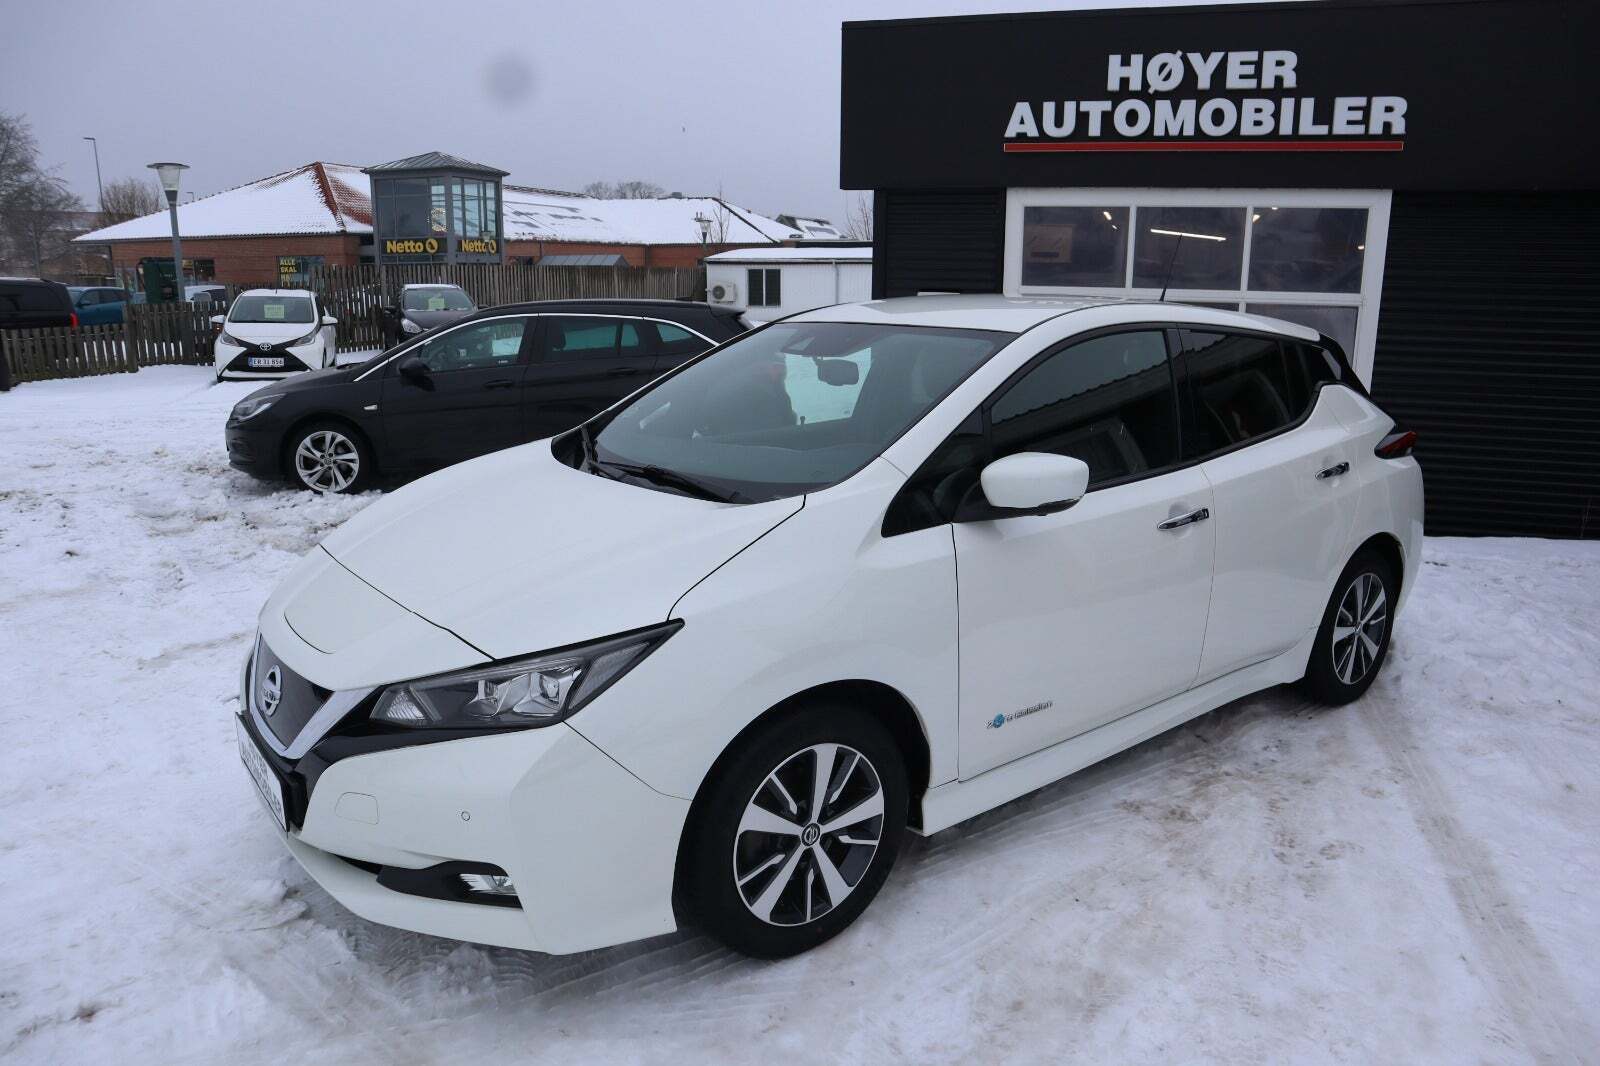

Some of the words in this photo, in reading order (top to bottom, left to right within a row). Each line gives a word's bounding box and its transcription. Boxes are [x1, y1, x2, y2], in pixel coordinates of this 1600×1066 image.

[1107, 50, 1298, 94] HØYER
[1003, 96, 1408, 137] AUTOMOBILER
[386, 240, 424, 253] Netto
[461, 239, 487, 253] Netto
